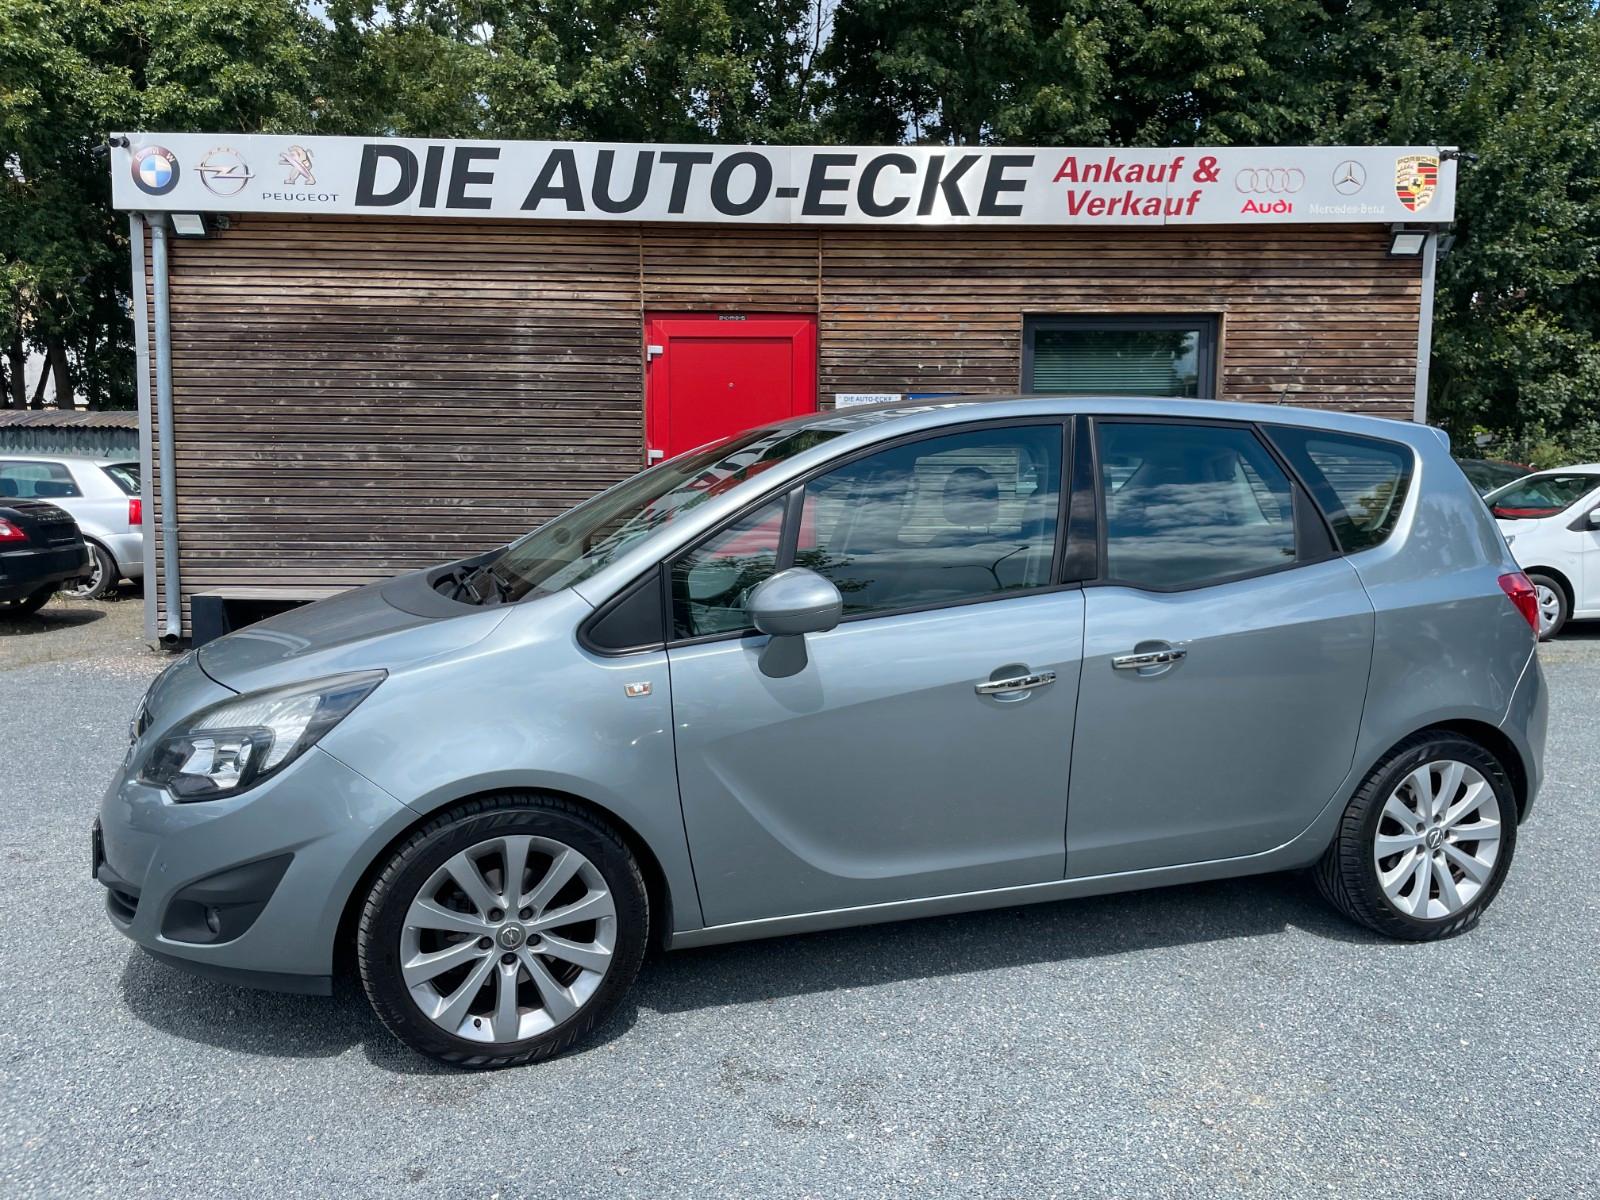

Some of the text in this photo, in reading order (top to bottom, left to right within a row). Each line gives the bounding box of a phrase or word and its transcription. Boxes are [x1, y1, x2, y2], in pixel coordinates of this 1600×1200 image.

[135, 146, 175, 162] BMW
[1397, 156, 1437, 165] PORSCHE
[1052, 156, 1221, 183] Ankauf &
[354, 143, 1036, 218] DIE AUTO-ECKE
[262, 192, 339, 202] PEUGEOT
[1066, 190, 1203, 216] Verkauf
[1241, 199, 1293, 214] Audi
[1309, 203, 1385, 215] Mercedes-Benz
